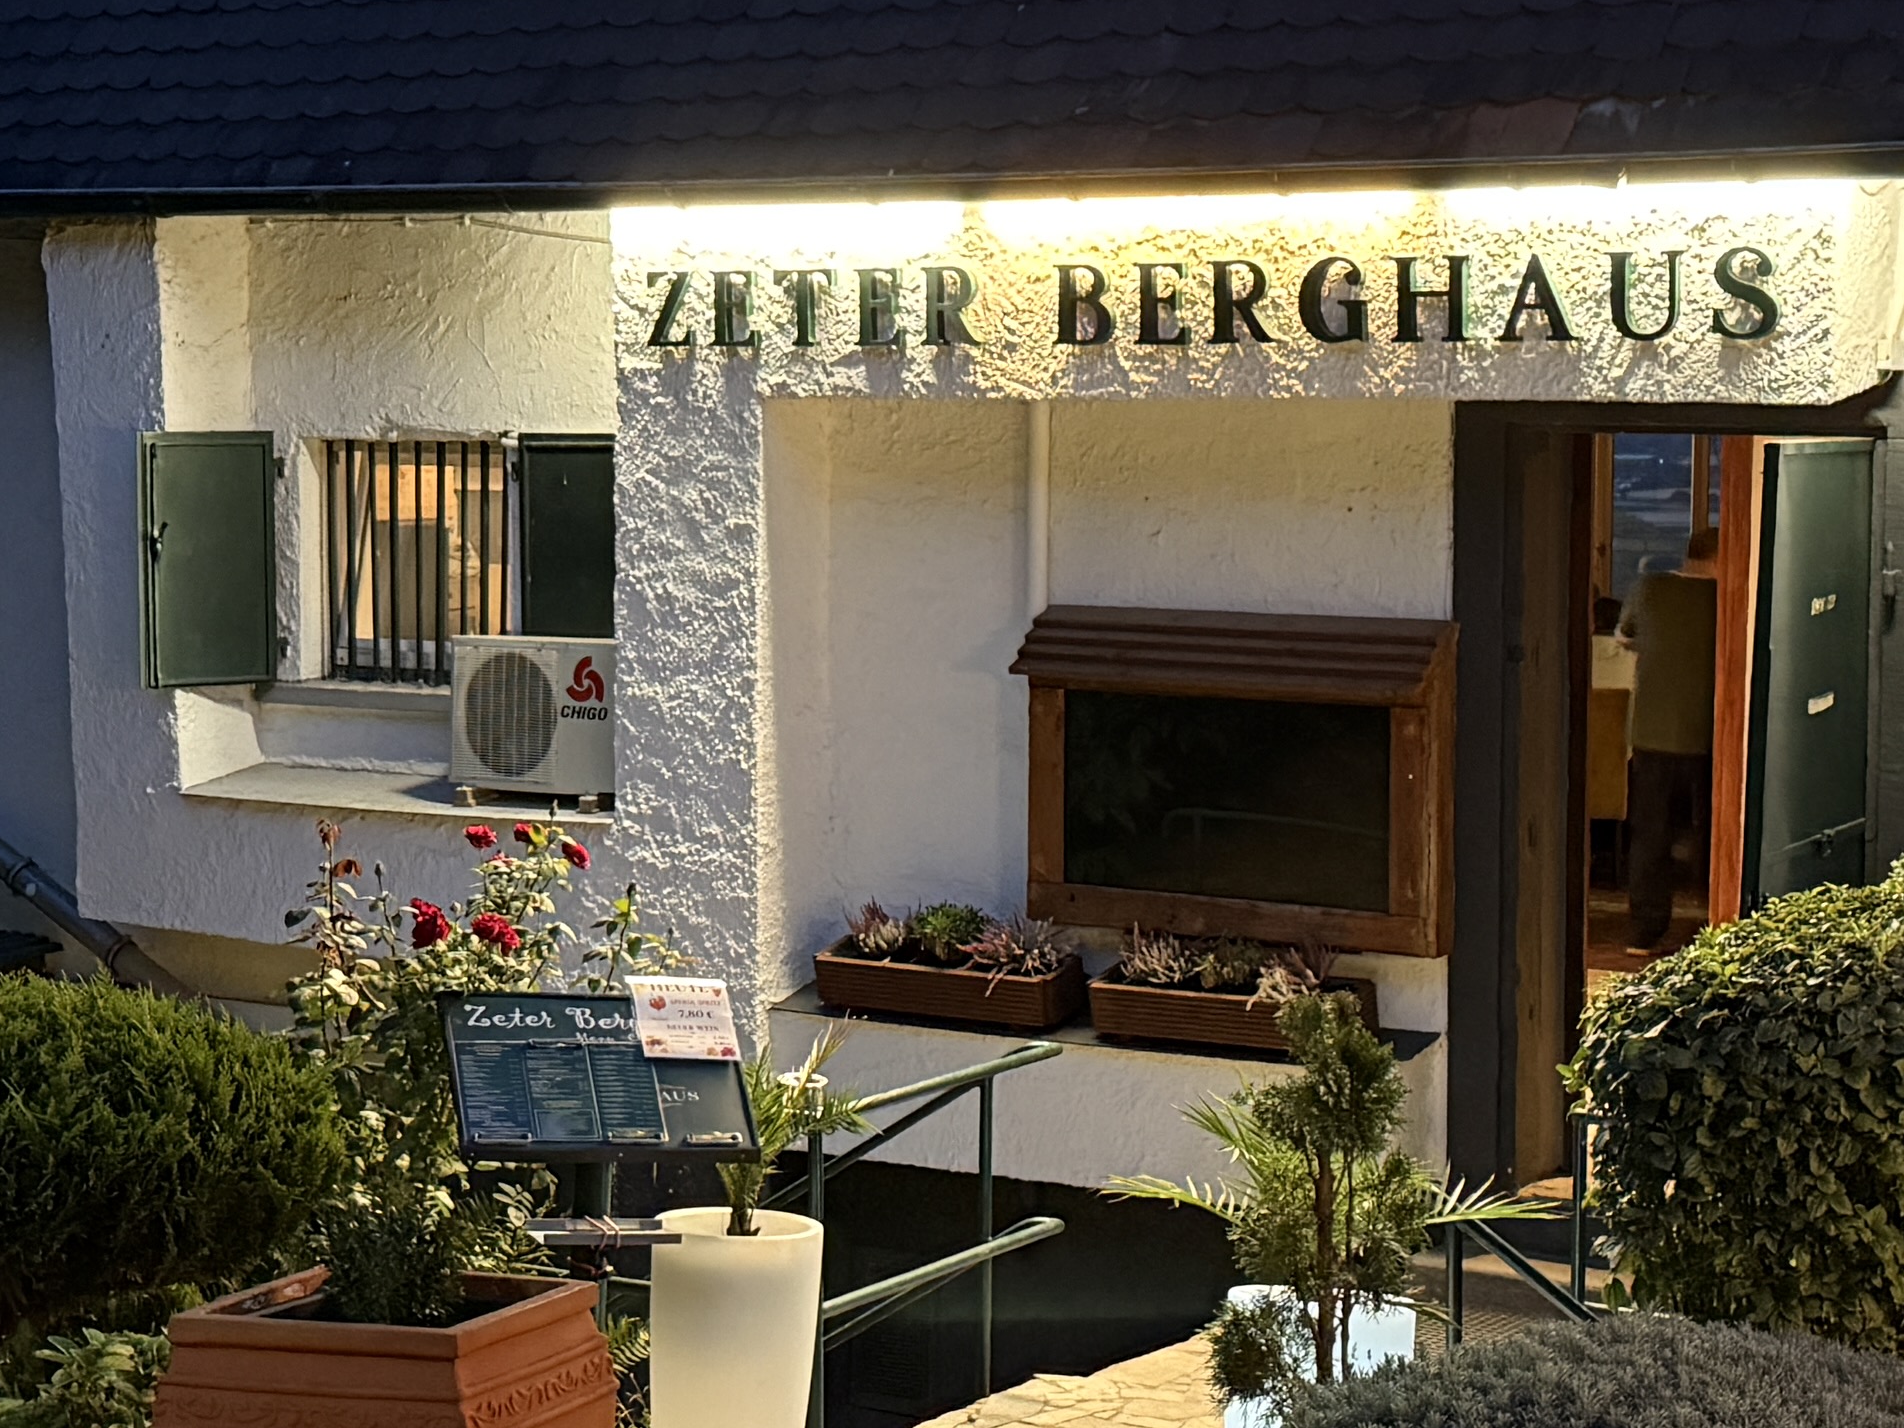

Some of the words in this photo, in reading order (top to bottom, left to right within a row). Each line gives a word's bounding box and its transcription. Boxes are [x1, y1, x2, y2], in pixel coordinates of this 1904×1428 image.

[646, 266, 983, 347] ZETER
[1053, 245, 1781, 345] BERGHAUS
[560, 705, 608, 721] CHIGO
[464, 1004, 556, 1029] Zeter
